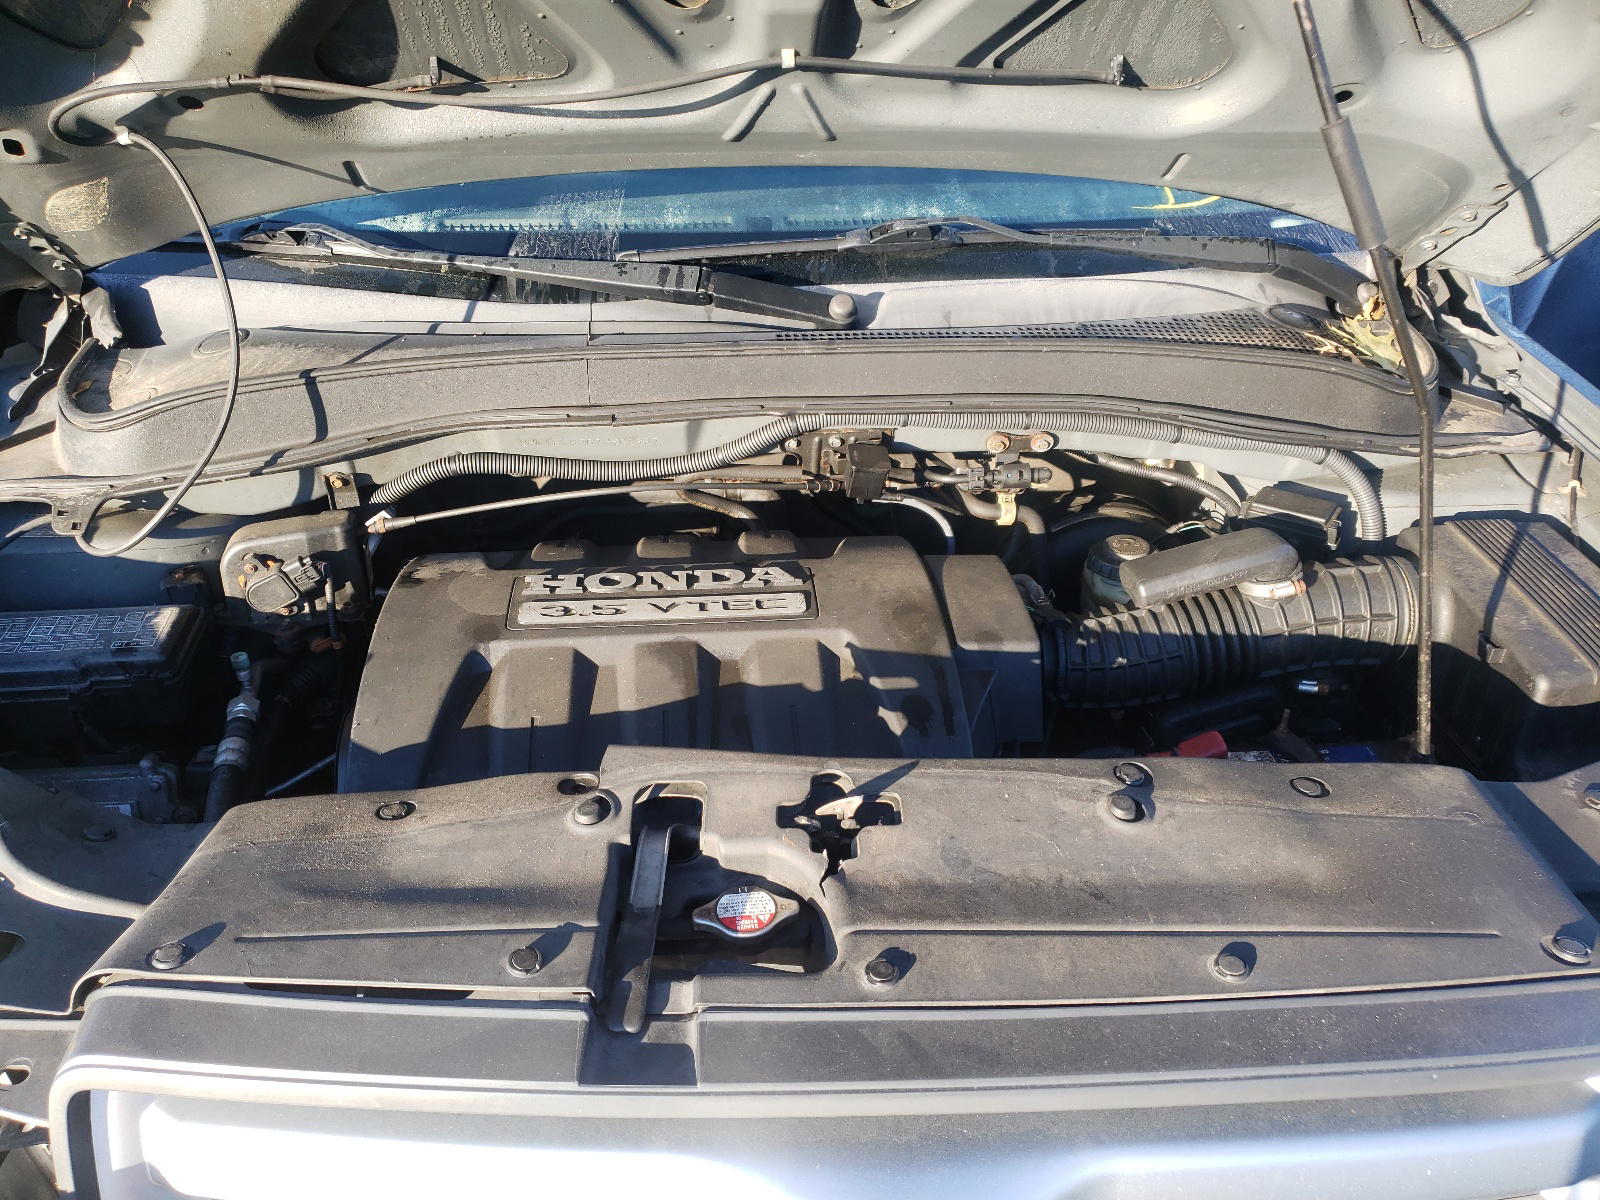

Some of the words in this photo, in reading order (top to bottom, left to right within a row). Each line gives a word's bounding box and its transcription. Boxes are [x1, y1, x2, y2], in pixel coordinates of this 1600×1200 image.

[521, 566, 804, 596] HONDA
[540, 602, 632, 617] 3.5
[646, 597, 791, 614] VTEC
